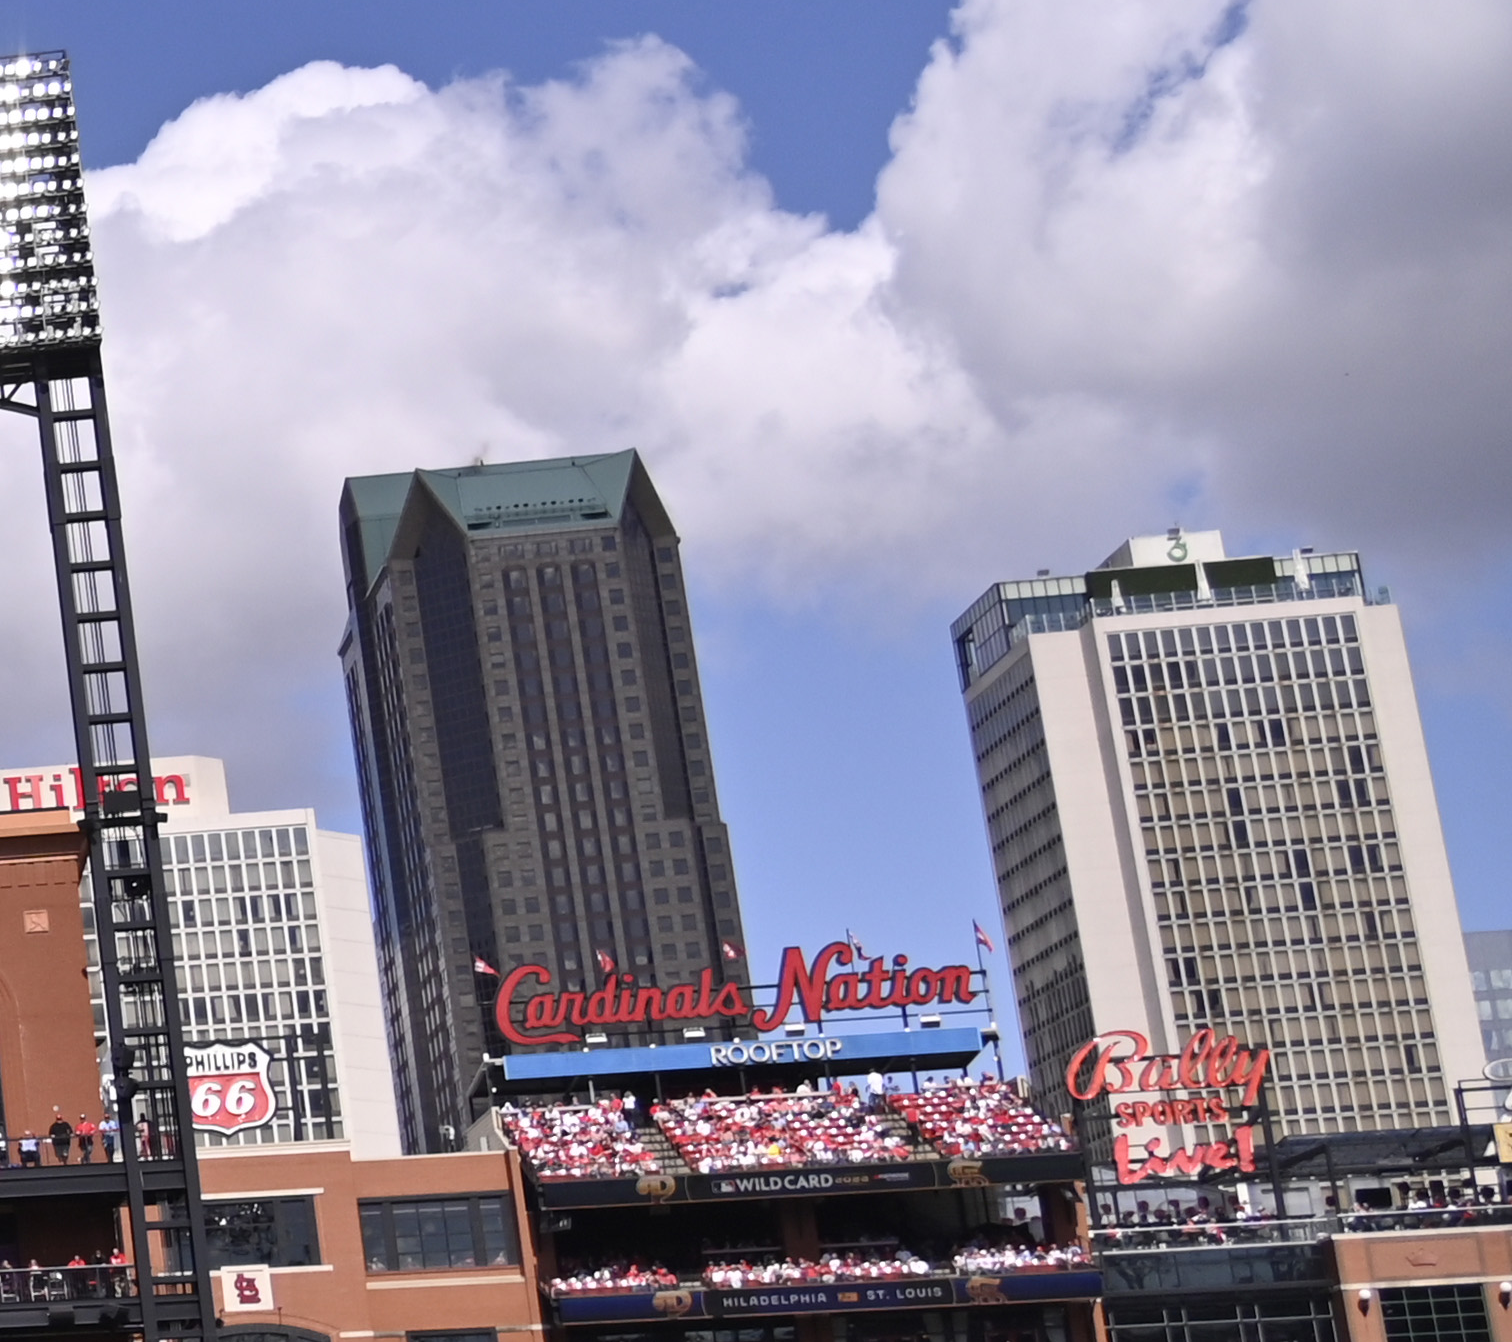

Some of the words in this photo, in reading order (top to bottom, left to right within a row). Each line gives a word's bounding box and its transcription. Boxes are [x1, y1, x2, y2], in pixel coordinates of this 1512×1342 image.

[495, 964, 748, 1045] Cardinals
[751, 941, 978, 1032] Nation
[185, 1051, 258, 1072] PHILLIPS
[710, 1039, 842, 1068] ROOFTOP
[1066, 1028, 1270, 1106] Bally
[191, 1080, 258, 1118] 66
[1115, 1097, 1229, 1128] SPORTS
[1114, 1125, 1257, 1185] Live!
[735, 1175, 782, 1193] WILD
[784, 1173, 834, 1190] CARD
[866, 1289, 890, 1301] ST.
[896, 1287, 943, 1299] LOUIS
